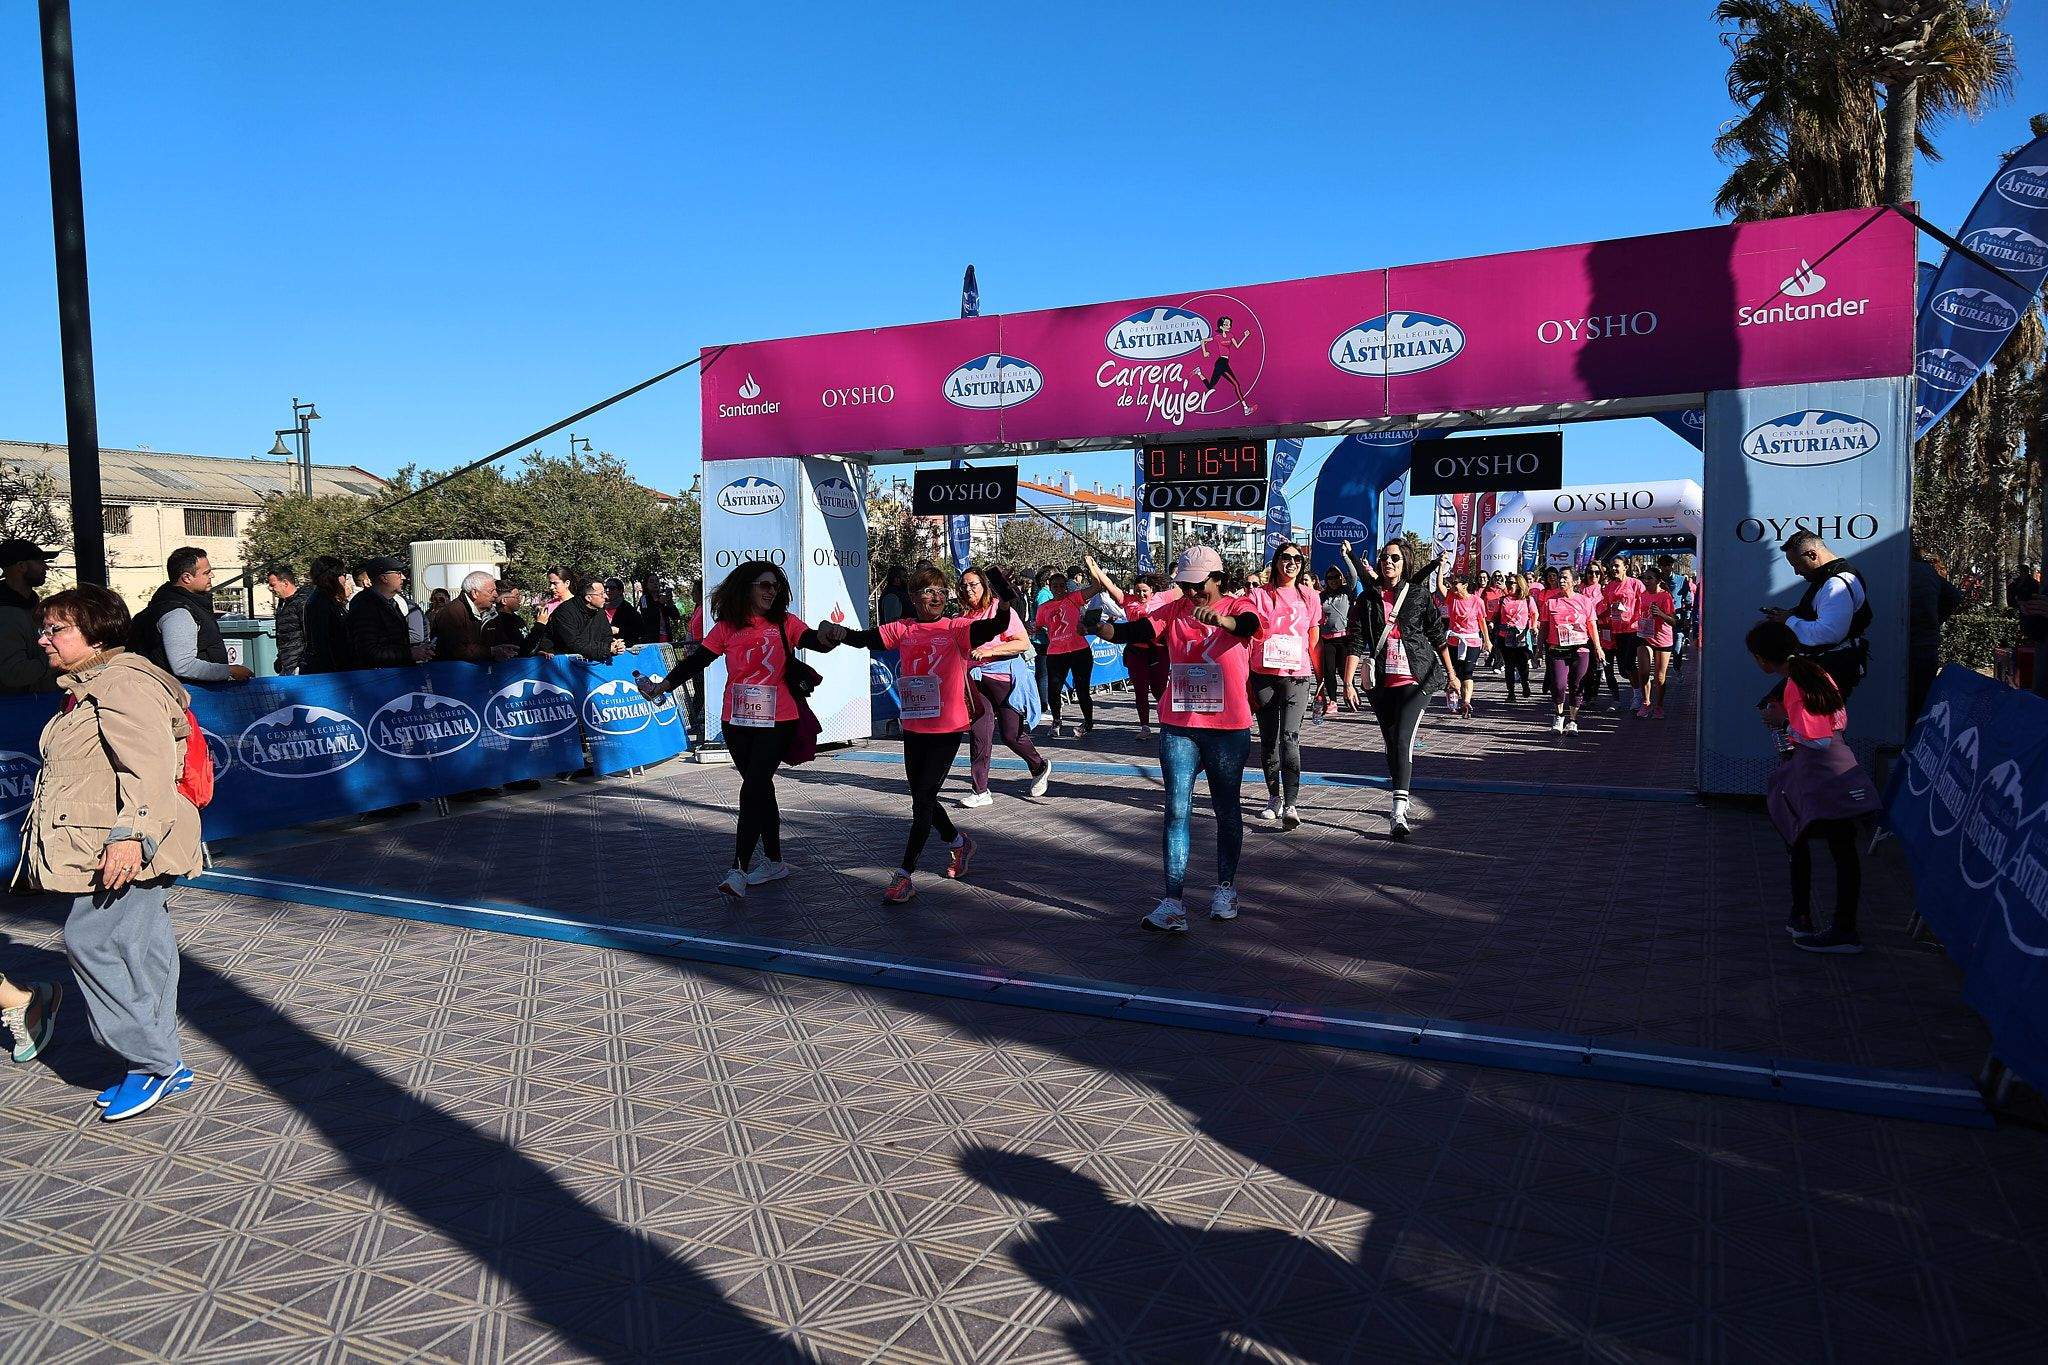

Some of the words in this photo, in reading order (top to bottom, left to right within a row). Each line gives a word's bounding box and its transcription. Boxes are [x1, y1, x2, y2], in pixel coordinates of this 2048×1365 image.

[2000, 175, 2048, 199] ASTUR
[1967, 236, 2044, 267] ASTURIANA
[1738, 298, 1870, 326] Santander
[1936, 297, 2009, 327] ASTURIANA
[1129, 325, 1164, 333] CENTRAL
[1166, 320, 1200, 329] LECHERA
[1360, 333, 1401, 344] CENTRAL
[1405, 328, 1450, 338] LECHERA
[1537, 311, 1658, 344] OYSHO
[1113, 329, 1203, 350] ASTURIANA
[1339, 338, 1455, 363] ASTURIANA
[965, 373, 996, 381] CENTRAL
[1096, 360, 1184, 388] Carrera
[822, 384, 894, 408] OYSHO
[950, 378, 1036, 398] ASTURIANA
[719, 400, 780, 418] Santander
[1117, 387, 1134, 406] de
[1136, 386, 1149, 406] la
[1145, 379, 1216, 425] Mujer
[1361, 430, 1414, 440] ASTURIANA
[1772, 429, 1816, 438] CENTRAL
[1752, 434, 1869, 455] ASTURIANA
[1434, 453, 1539, 478] OYSHO
[722, 492, 780, 507] ASTURIANA
[818, 489, 857, 509] ASTURIANA
[929, 482, 1001, 501] OYSHO
[1150, 485, 1260, 508] OYSHO
[1553, 491, 1654, 512] OYSHO
[1387, 479, 1404, 533] SHO
[1459, 493, 1470, 542] Santander
[1736, 514, 1878, 542] OYSHO
[1317, 526, 1364, 538] ASTURIANA
[716, 548, 786, 568] OYSHO
[814, 548, 861, 568] OYSHO
[1188, 684, 1207, 693] 016
[495, 705, 577, 729] ASTURIANA
[591, 702, 650, 725] ASTURIANA
[744, 702, 762, 711] 016
[267, 730, 309, 740] CENTRAL
[312, 724, 352, 735] LECHERA
[380, 718, 475, 746] ASTURIANA
[252, 735, 362, 764] ASTURIANA
